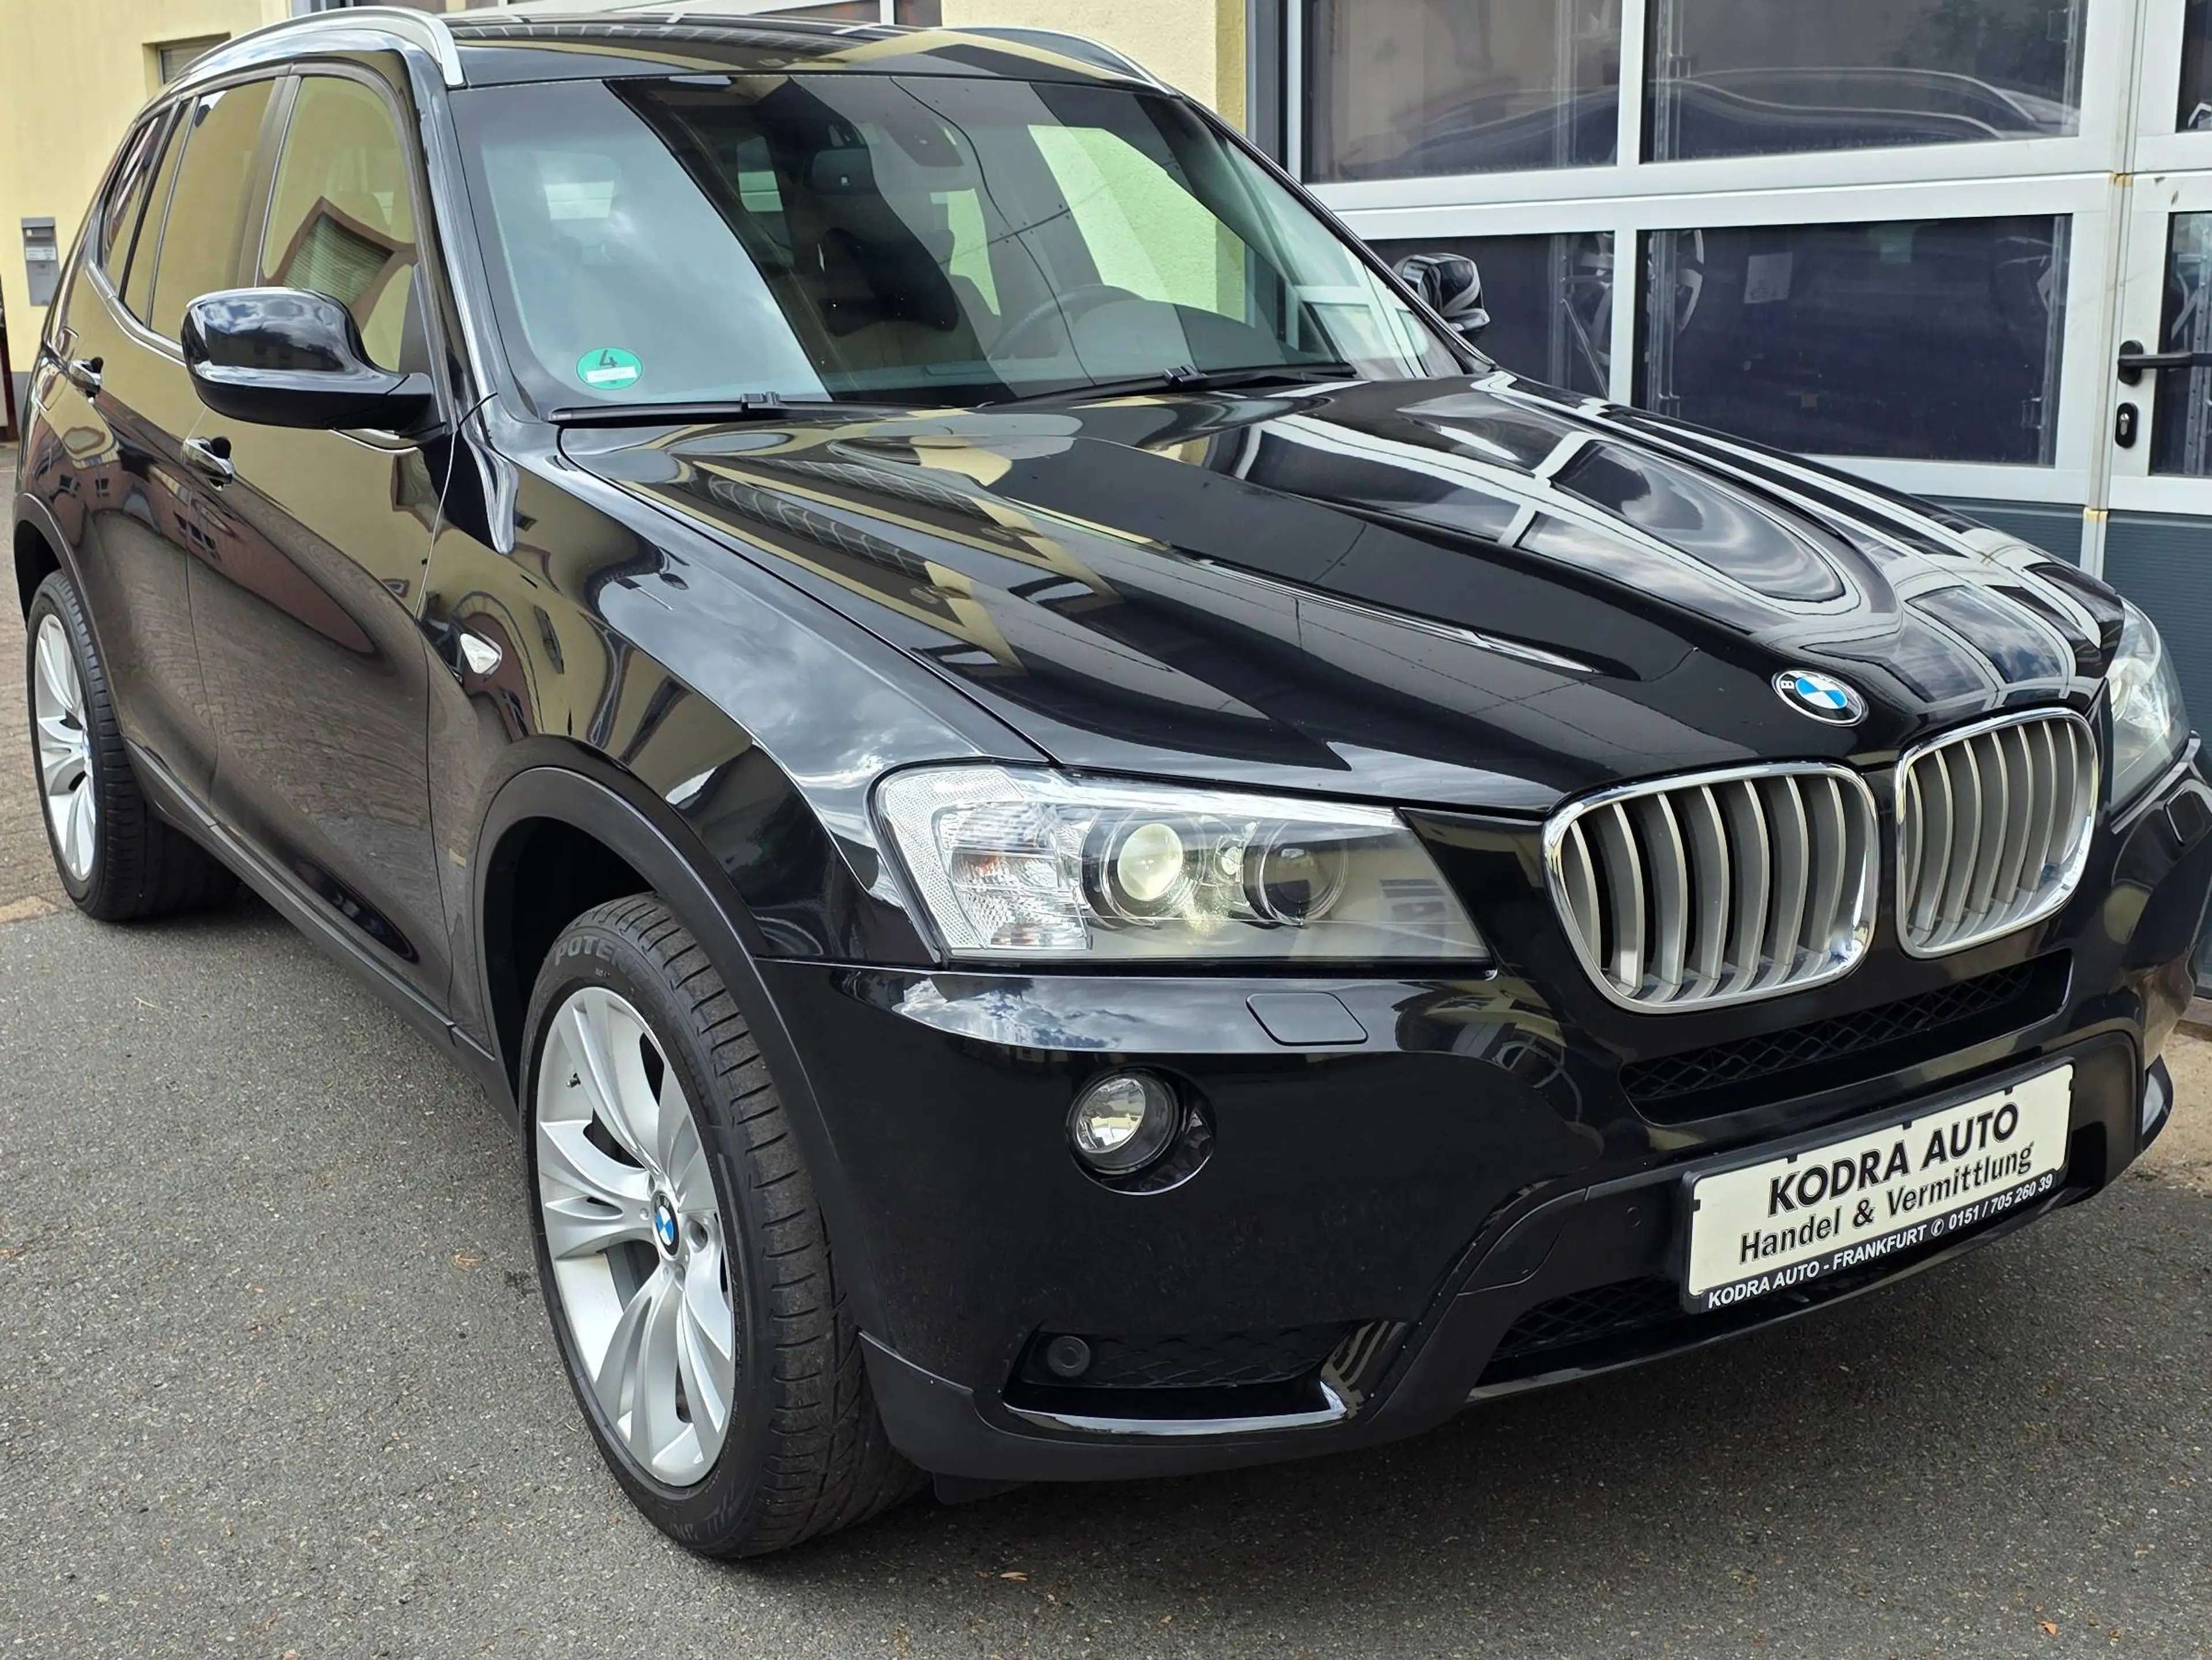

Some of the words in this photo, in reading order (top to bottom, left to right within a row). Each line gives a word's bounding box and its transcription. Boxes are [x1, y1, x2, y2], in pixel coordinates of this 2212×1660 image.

[600, 349, 617, 367] 4
[1739, 1206, 1841, 1265] Handel
[1852, 1198, 1874, 1229] &
[1886, 1141, 2034, 1218] Vermittlung
[1768, 1140, 1910, 1217] KODRA
[1920, 1102, 2018, 1171] AUTO
[1708, 1276, 1769, 1308] KODRA
[1773, 1261, 1820, 1289] AUTO
[1833, 1225, 1927, 1270] FRANKFURT
[1949, 1204, 1979, 1229] 0151
[1991, 1191, 2013, 1213] 705
[2014, 1181, 2037, 1204] 260
[2038, 1174, 2053, 1192] 39
